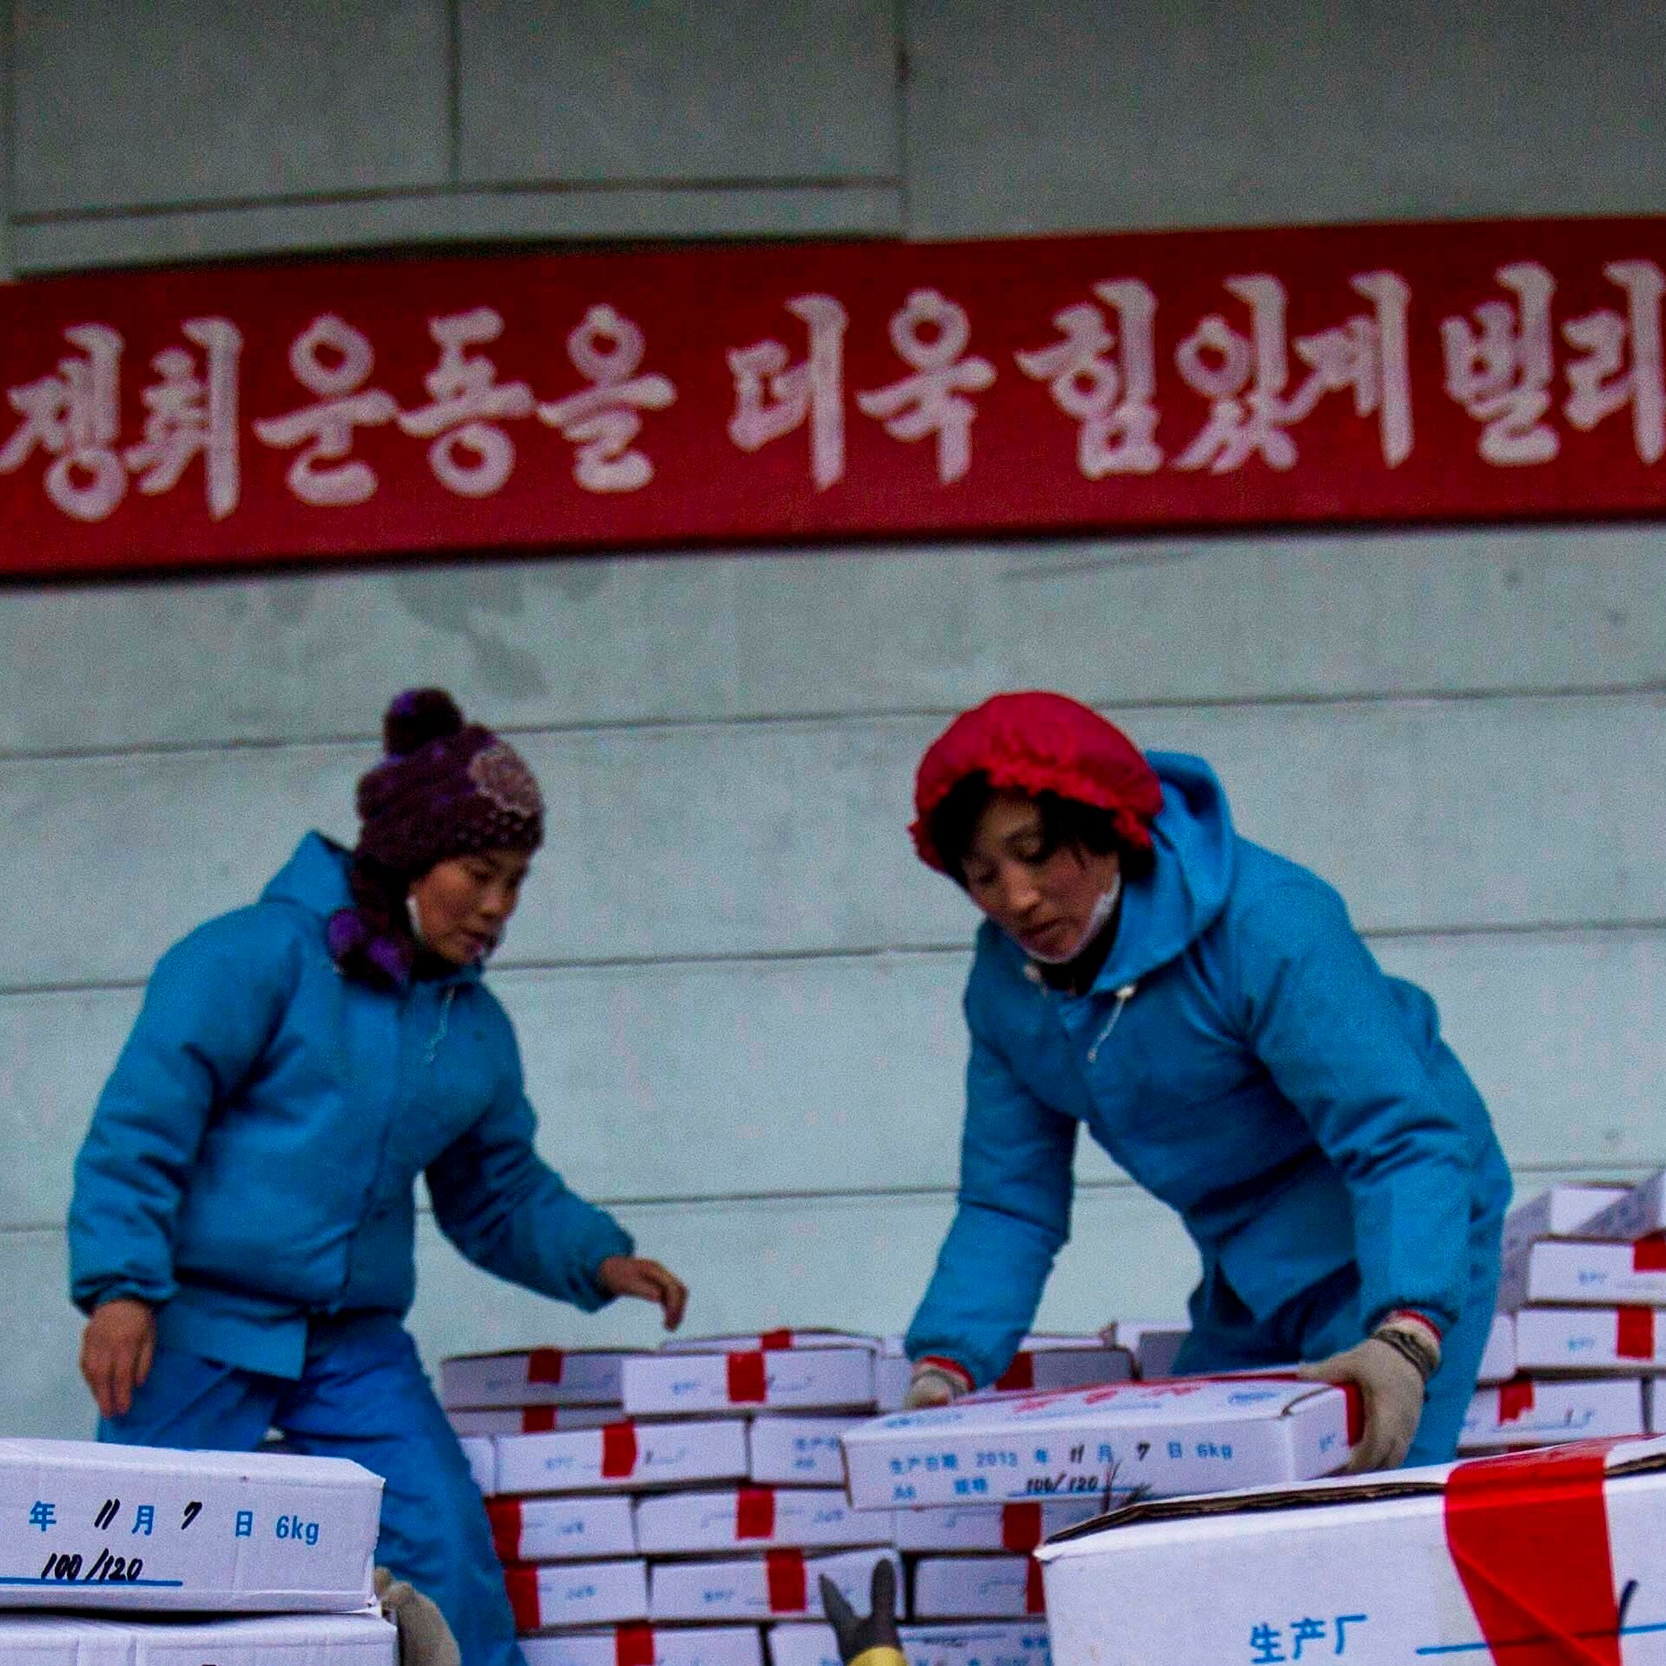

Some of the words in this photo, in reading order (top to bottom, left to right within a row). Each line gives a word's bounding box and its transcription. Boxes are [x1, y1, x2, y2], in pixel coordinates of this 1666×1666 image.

[728, 290, 996, 492] 더욱
[1016, 270, 1412, 480] 힘있게
[28, 1500, 57, 1533] 年
[94, 1498, 121, 1530] 11
[131, 1504, 155, 1536] 月
[181, 1501, 203, 1530] 7
[234, 1510, 254, 1538] 日
[275, 1515, 320, 1546] 6kg
[41, 1548, 143, 1581] 100/120
[1249, 1613, 1368, 1665] 生产厂
